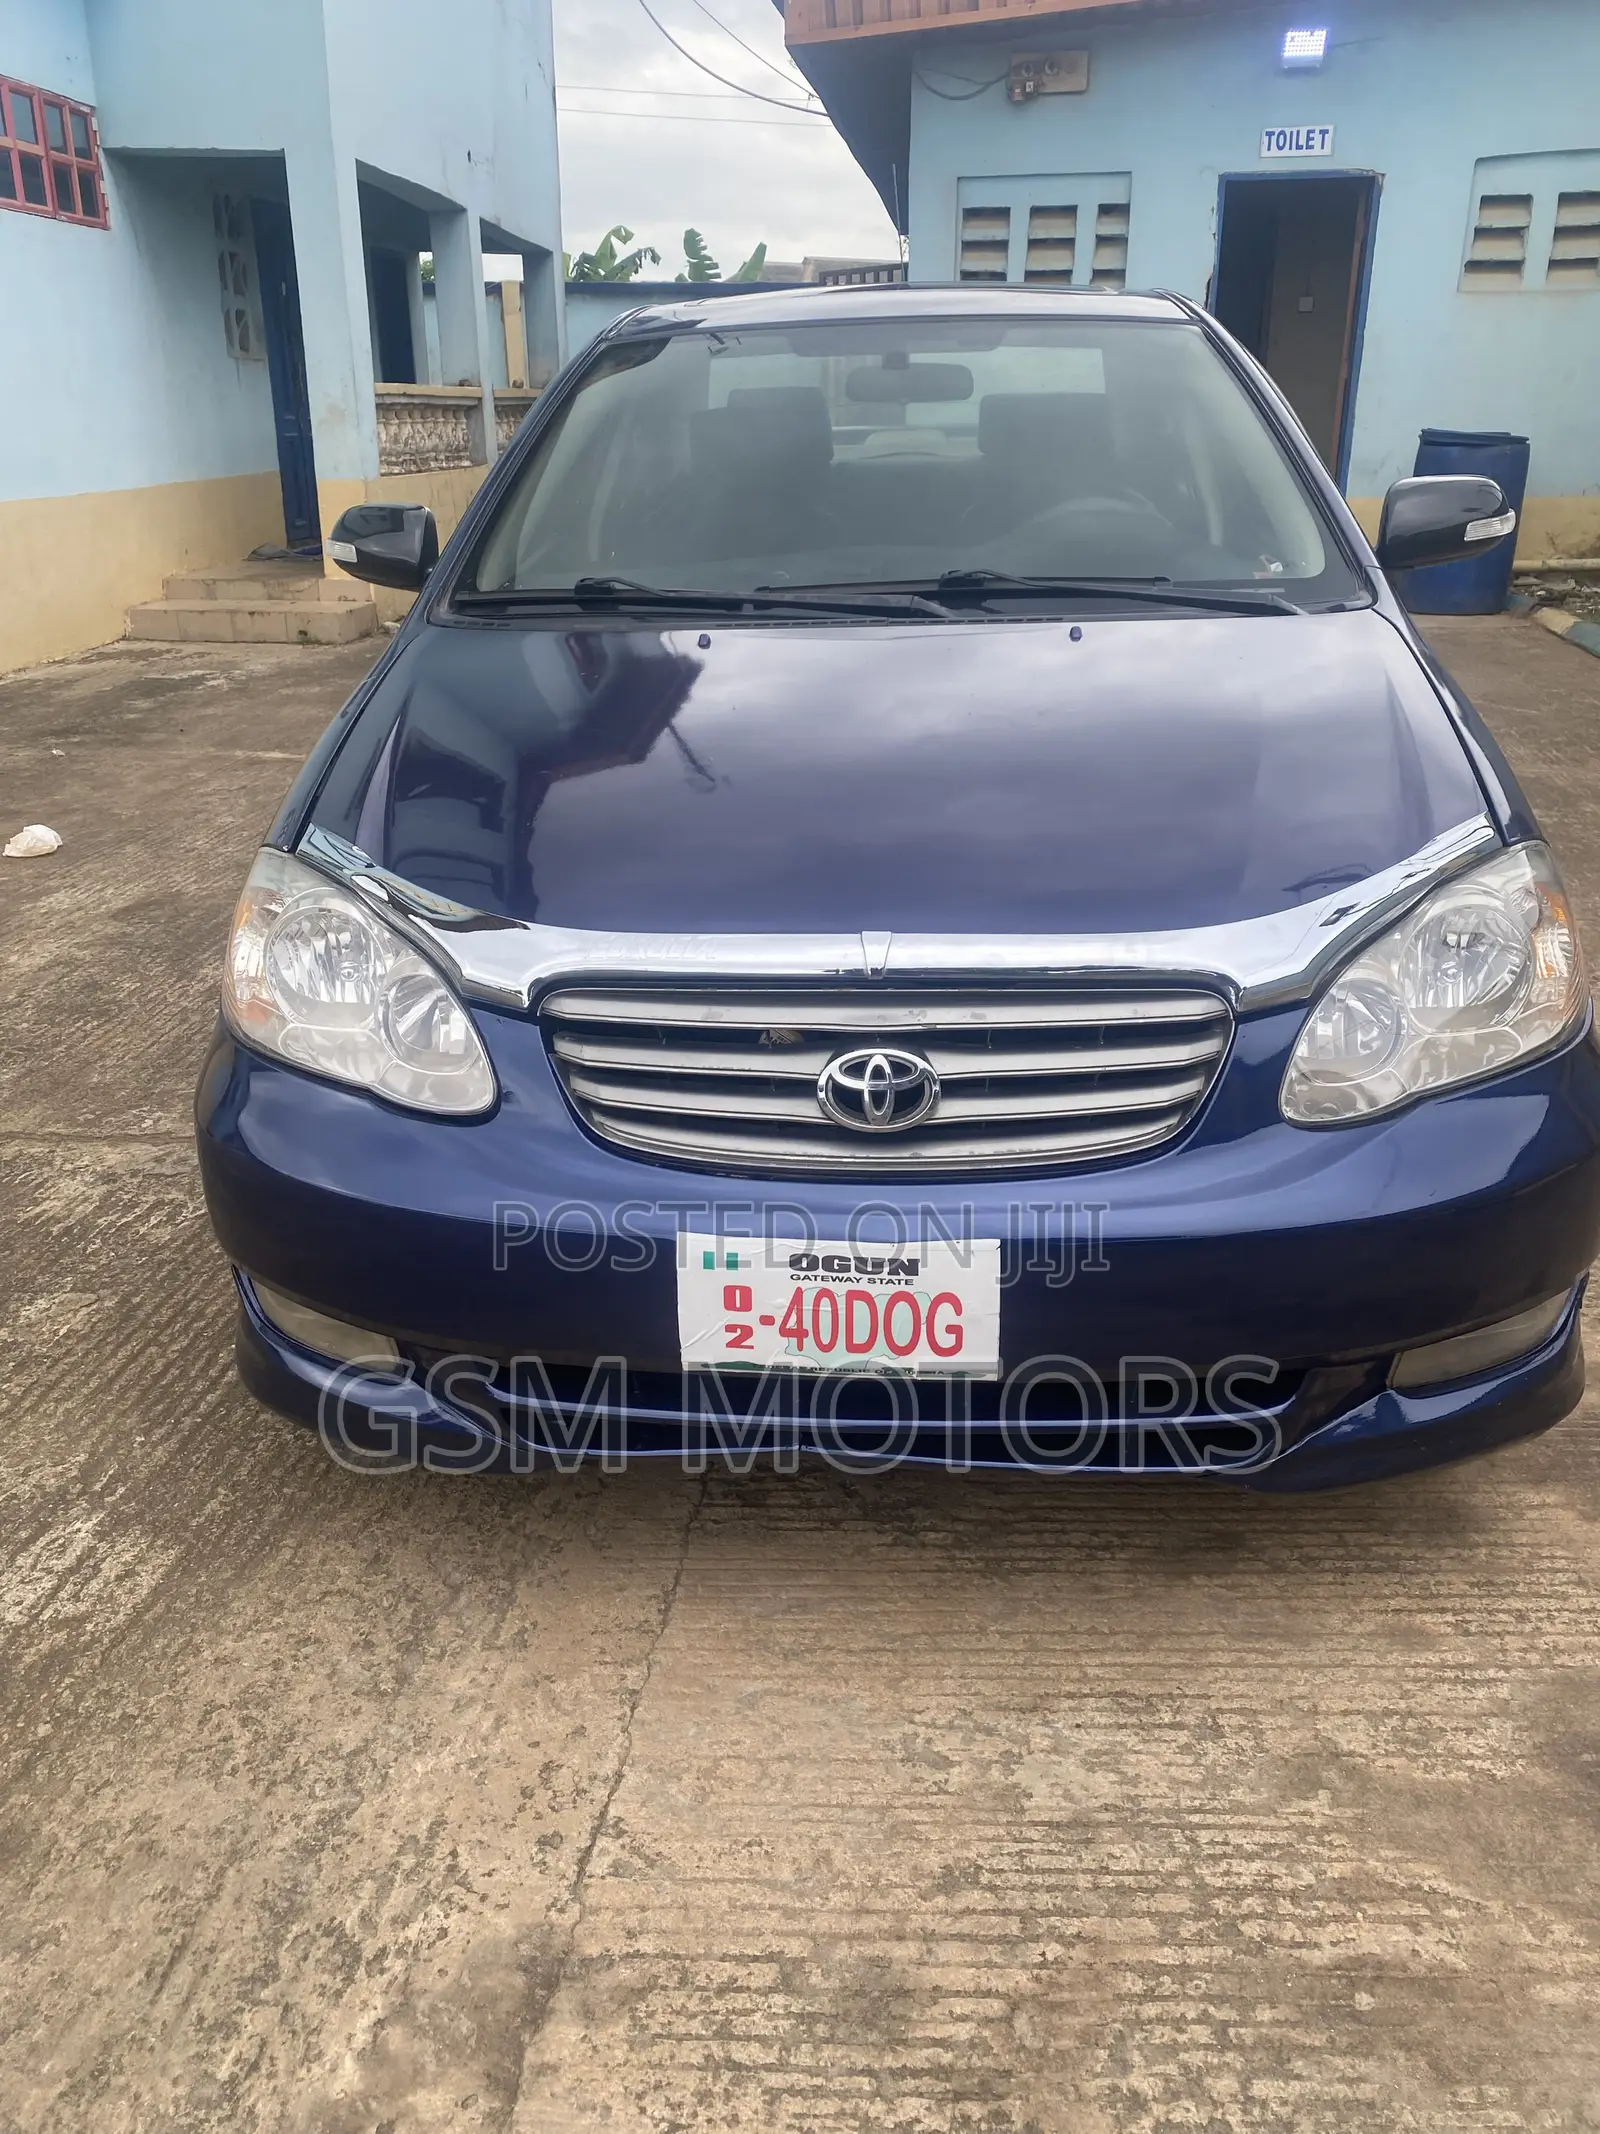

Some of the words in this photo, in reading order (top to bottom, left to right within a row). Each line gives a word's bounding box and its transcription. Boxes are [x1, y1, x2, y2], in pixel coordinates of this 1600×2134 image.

[1264, 128, 1330, 152] TOILET
[788, 1253, 921, 1277] OGUN
[789, 1273, 864, 1284] GATEWAY
[867, 1276, 915, 1286] STATE
